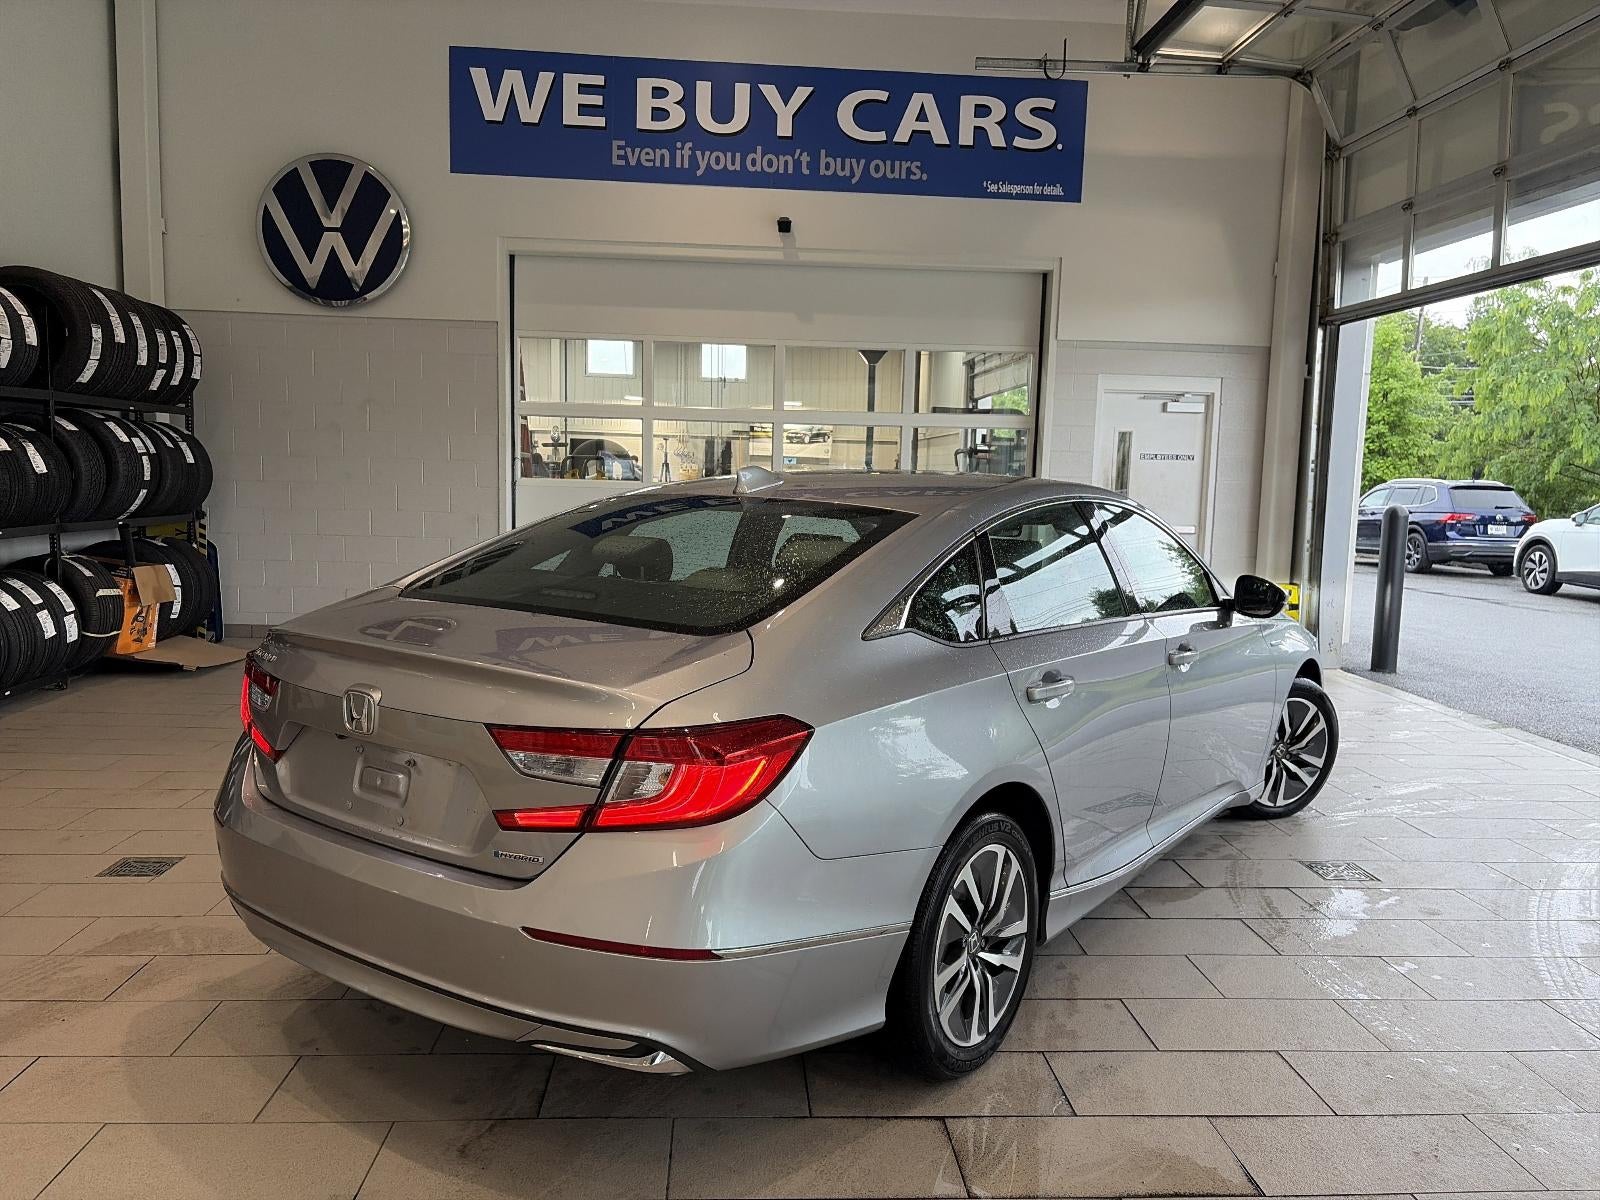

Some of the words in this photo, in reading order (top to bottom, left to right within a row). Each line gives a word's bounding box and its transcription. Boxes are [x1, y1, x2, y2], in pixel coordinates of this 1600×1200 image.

[469, 67, 606, 129] WE
[637, 77, 815, 138] BUY
[836, 89, 1063, 150] CARS.
[611, 140, 670, 167] Even
[675, 141, 692, 169] if
[695, 149, 741, 176] you
[746, 145, 810, 174] don't
[819, 149, 865, 185] buy
[869, 158, 928, 181] ours.
[998, 181, 1033, 196] Salesperson
[1034, 183, 1042, 195] for
[1043, 183, 1064, 196] details.
[499, 851, 542, 864] HYBRID
